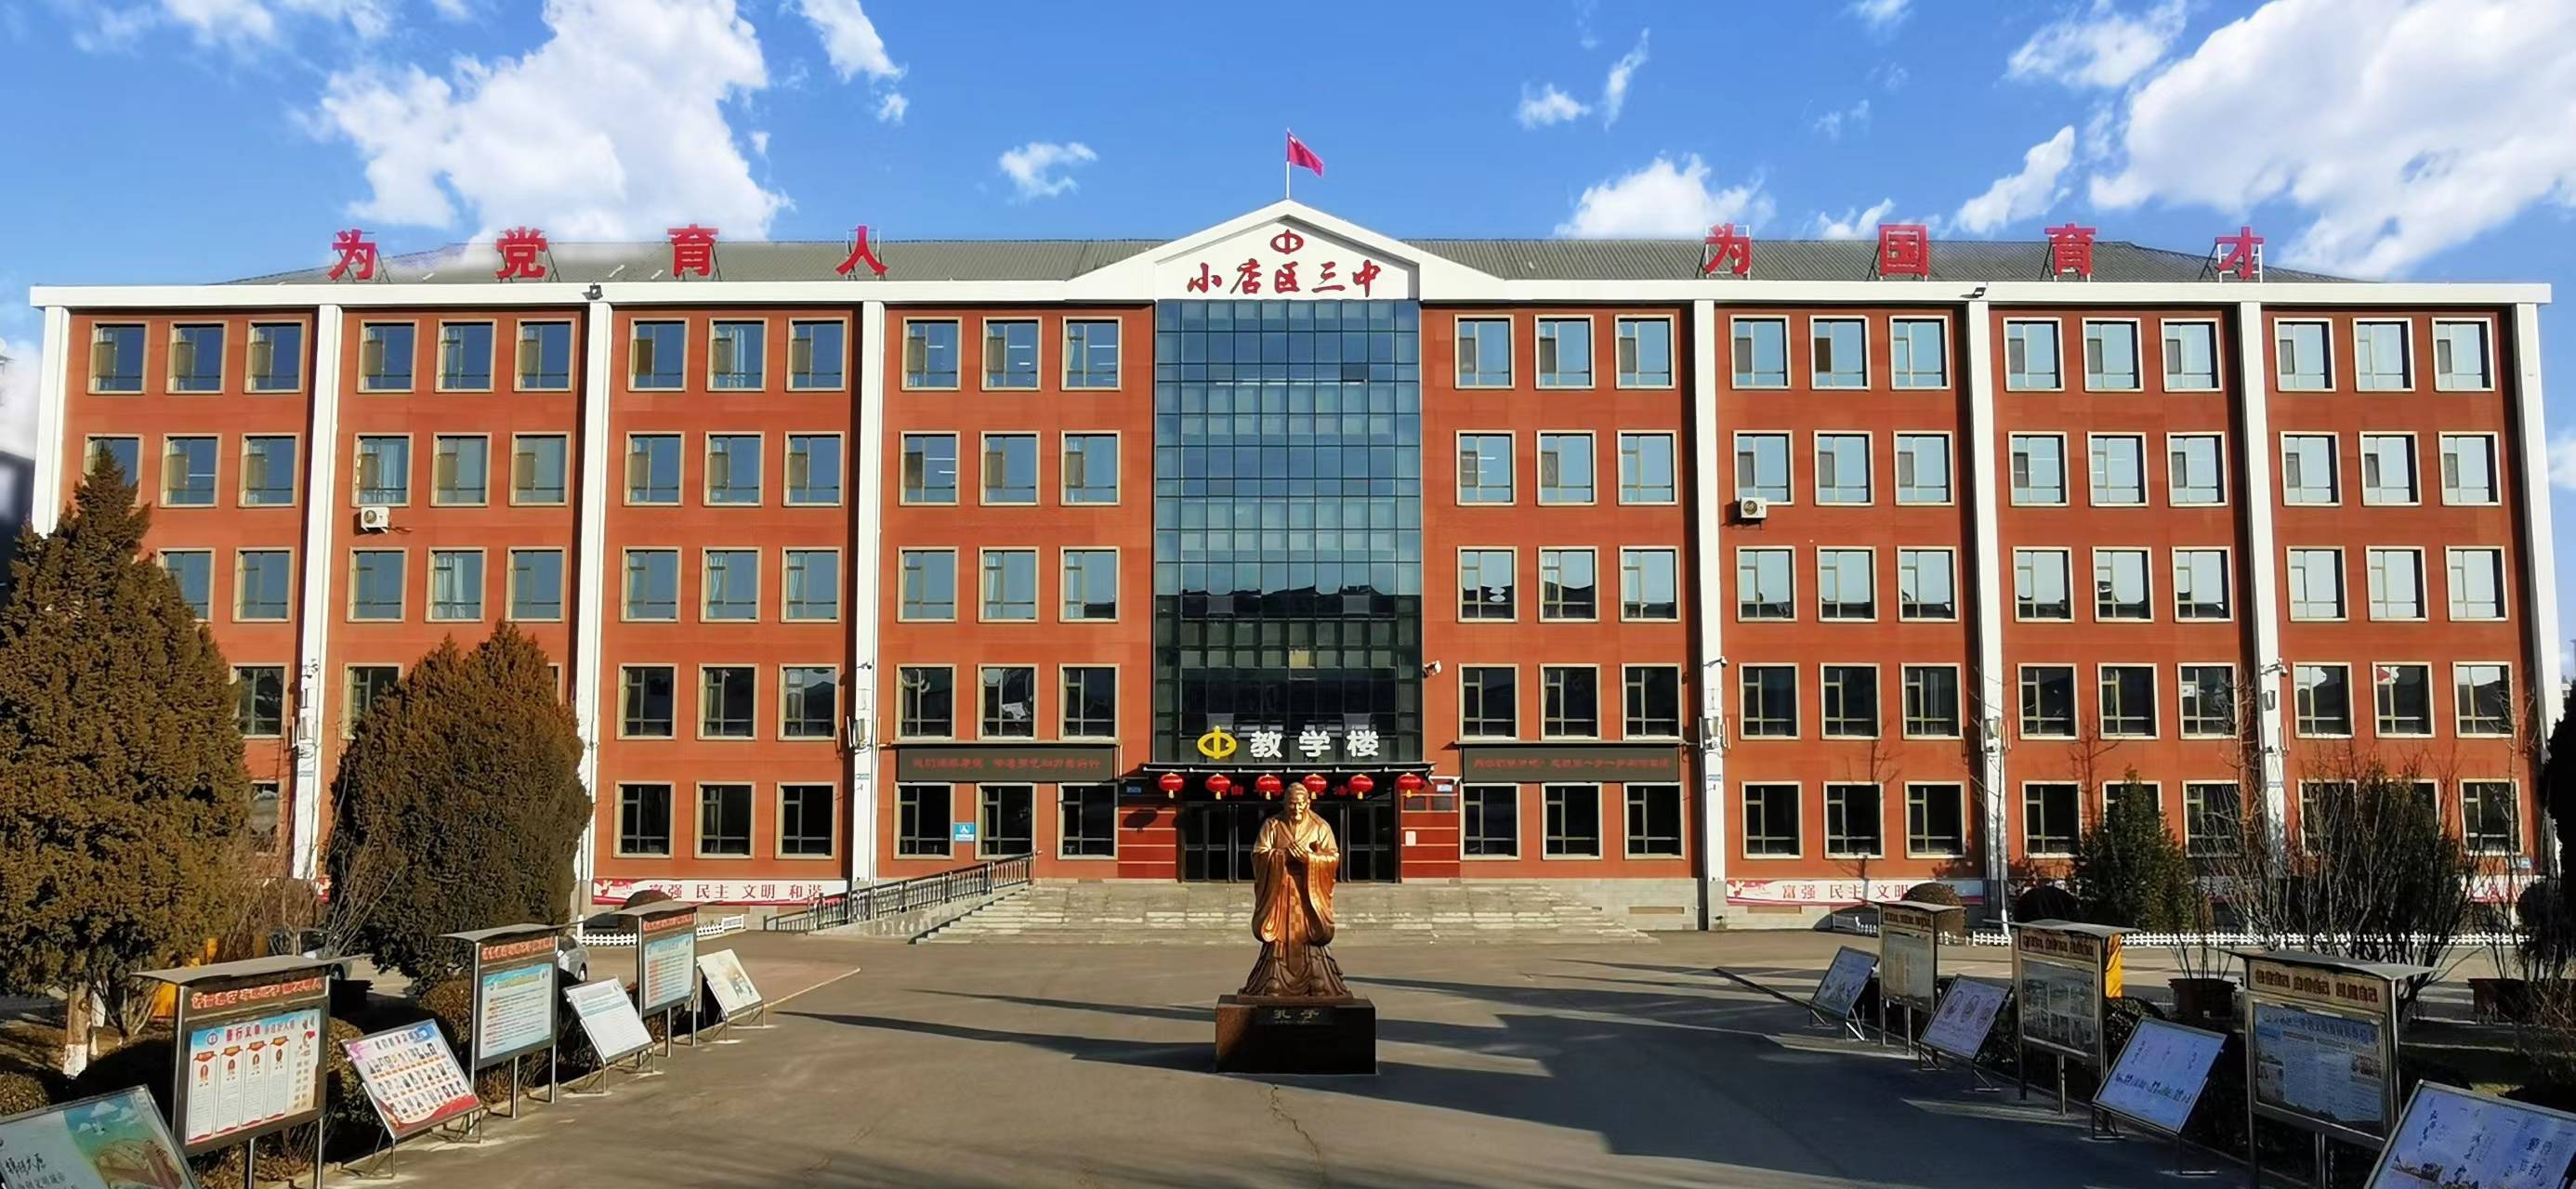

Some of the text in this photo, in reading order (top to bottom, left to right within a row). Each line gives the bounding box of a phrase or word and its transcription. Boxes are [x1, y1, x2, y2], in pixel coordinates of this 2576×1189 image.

[328, 224, 887, 279] 为党育人
[1705, 224, 2264, 280] 为国育才
[1187, 258, 1381, 297] 小店区三中
[1250, 730, 1379, 758] 教学楼
[696, 884, 729, 899] 民主
[742, 884, 775, 899] 文明
[1782, 884, 1816, 899] 富强
[1830, 884, 1862, 899] 民主
